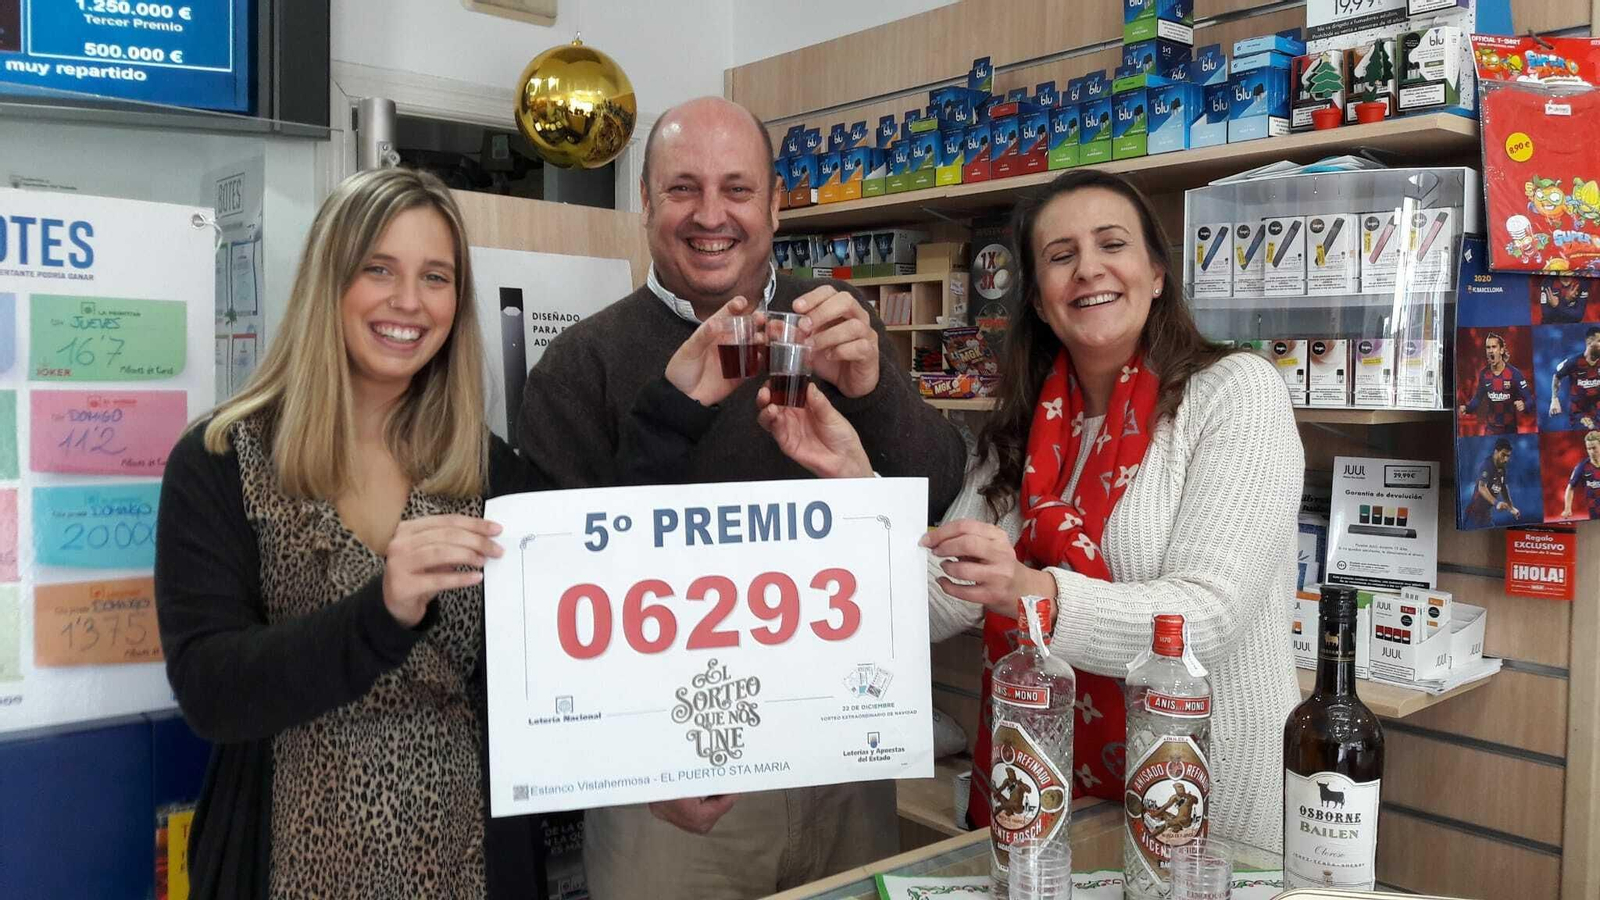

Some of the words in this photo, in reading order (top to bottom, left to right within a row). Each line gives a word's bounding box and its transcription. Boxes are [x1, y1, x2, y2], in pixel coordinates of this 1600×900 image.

[76, 0, 173, 19] 1.250.000
[178, 7, 191, 21] €
[84, 14, 129, 28] Tercer
[133, 17, 183, 32] Premio
[1430, 35, 1445, 47] blu
[84, 42, 164, 63] 500.000
[169, 49, 184, 64] €
[5, 60, 50, 77] muy
[56, 64, 147, 82] repartido
[1201, 59, 1216, 72] blu
[976, 68, 987, 79] blu
[1088, 84, 1101, 96] blu
[1235, 88, 1251, 102] blu
[1041, 93, 1053, 106] blu
[1212, 99, 1228, 113] blu
[1154, 100, 1170, 115] blu
[955, 110, 967, 122] blu
[1118, 108, 1133, 121] blu
[1054, 122, 1068, 134] blu
[1085, 116, 1099, 128] blu
[995, 133, 1008, 145] blu
[1023, 128, 1036, 140] blu
[946, 142, 958, 154] blu
[968, 138, 980, 150] blu
[895, 152, 907, 164] blu
[913, 146, 924, 158] blu
[1474, 274, 1492, 283] 2020
[70, 315, 123, 330] JUEVES
[532, 311, 580, 323] DISEÑADO
[533, 325, 558, 335] PARA
[1343, 464, 1366, 476] JUUL
[652, 500, 833, 548] PREMIO
[1525, 533, 1554, 543] Regalo
[1514, 541, 1565, 551] EXCLUSIVO
[1513, 564, 1565, 583] ¡HOLA!
[1376, 601, 1391, 611] JUUL
[556, 567, 862, 661] 06293
[1293, 639, 1312, 653] JUUL
[1382, 646, 1402, 660] JUUL
[691, 657, 731, 689] EL
[671, 675, 761, 724] SORTEO
[1014, 689, 1039, 702] MONO
[861, 702, 895, 710] DICIEMBRE
[1155, 696, 1177, 711] ANIS
[1184, 700, 1206, 712] MONO
[563, 712, 602, 722] Nacional
[693, 710, 726, 731] QUE
[728, 700, 761, 727] NOS
[685, 726, 746, 767] UNE
[876, 746, 905, 756] Apuestas
[869, 754, 891, 763] Estado
[1016, 750, 1051, 786] REFINADO
[530, 784, 575, 797] Estanco
[577, 776, 651, 793] Vistahermosa
[660, 771, 675, 783] EL
[678, 765, 726, 782] PUERTO
[729, 764, 751, 776] STA
[754, 760, 791, 774] MARIA
[1133, 762, 1165, 791] ANISADO
[1299, 804, 1362, 824] OSBORNE
[1012, 818, 1043, 844] BOSCH
[1300, 820, 1359, 840] BAILEN
